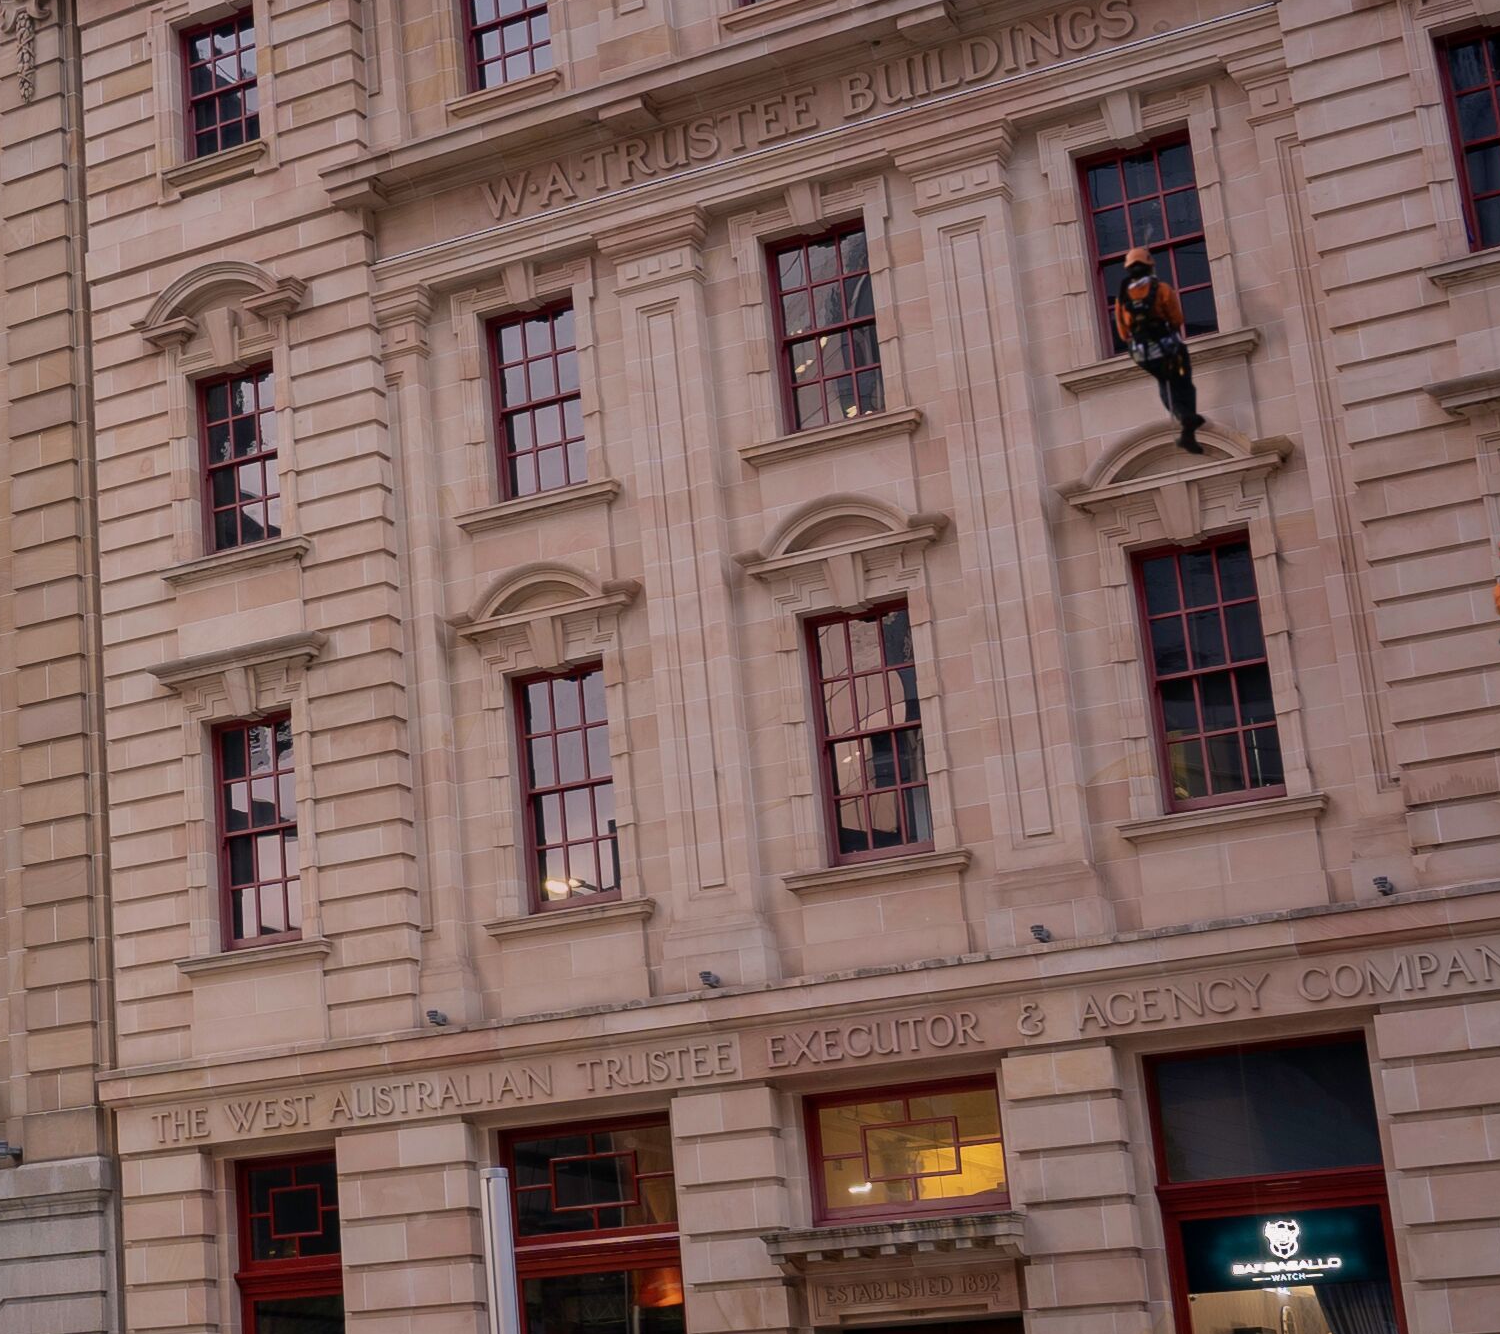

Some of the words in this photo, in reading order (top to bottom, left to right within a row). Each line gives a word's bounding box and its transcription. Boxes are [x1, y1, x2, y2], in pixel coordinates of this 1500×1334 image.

[151, 1106, 211, 1144] THE
[223, 1093, 316, 1134] WEST
[331, 1063, 553, 1124] AUSTRALIAN
[577, 1040, 739, 1094] TRUSTEE
[765, 1009, 984, 1069] EXECUTOR
[1017, 1001, 1046, 1038] &
[1079, 972, 1270, 1033] AGENCY
[824, 1275, 954, 1304] ESTABLISHED
[959, 1273, 1001, 1294] 1892
[1270, 1272, 1305, 1282] WATCH
